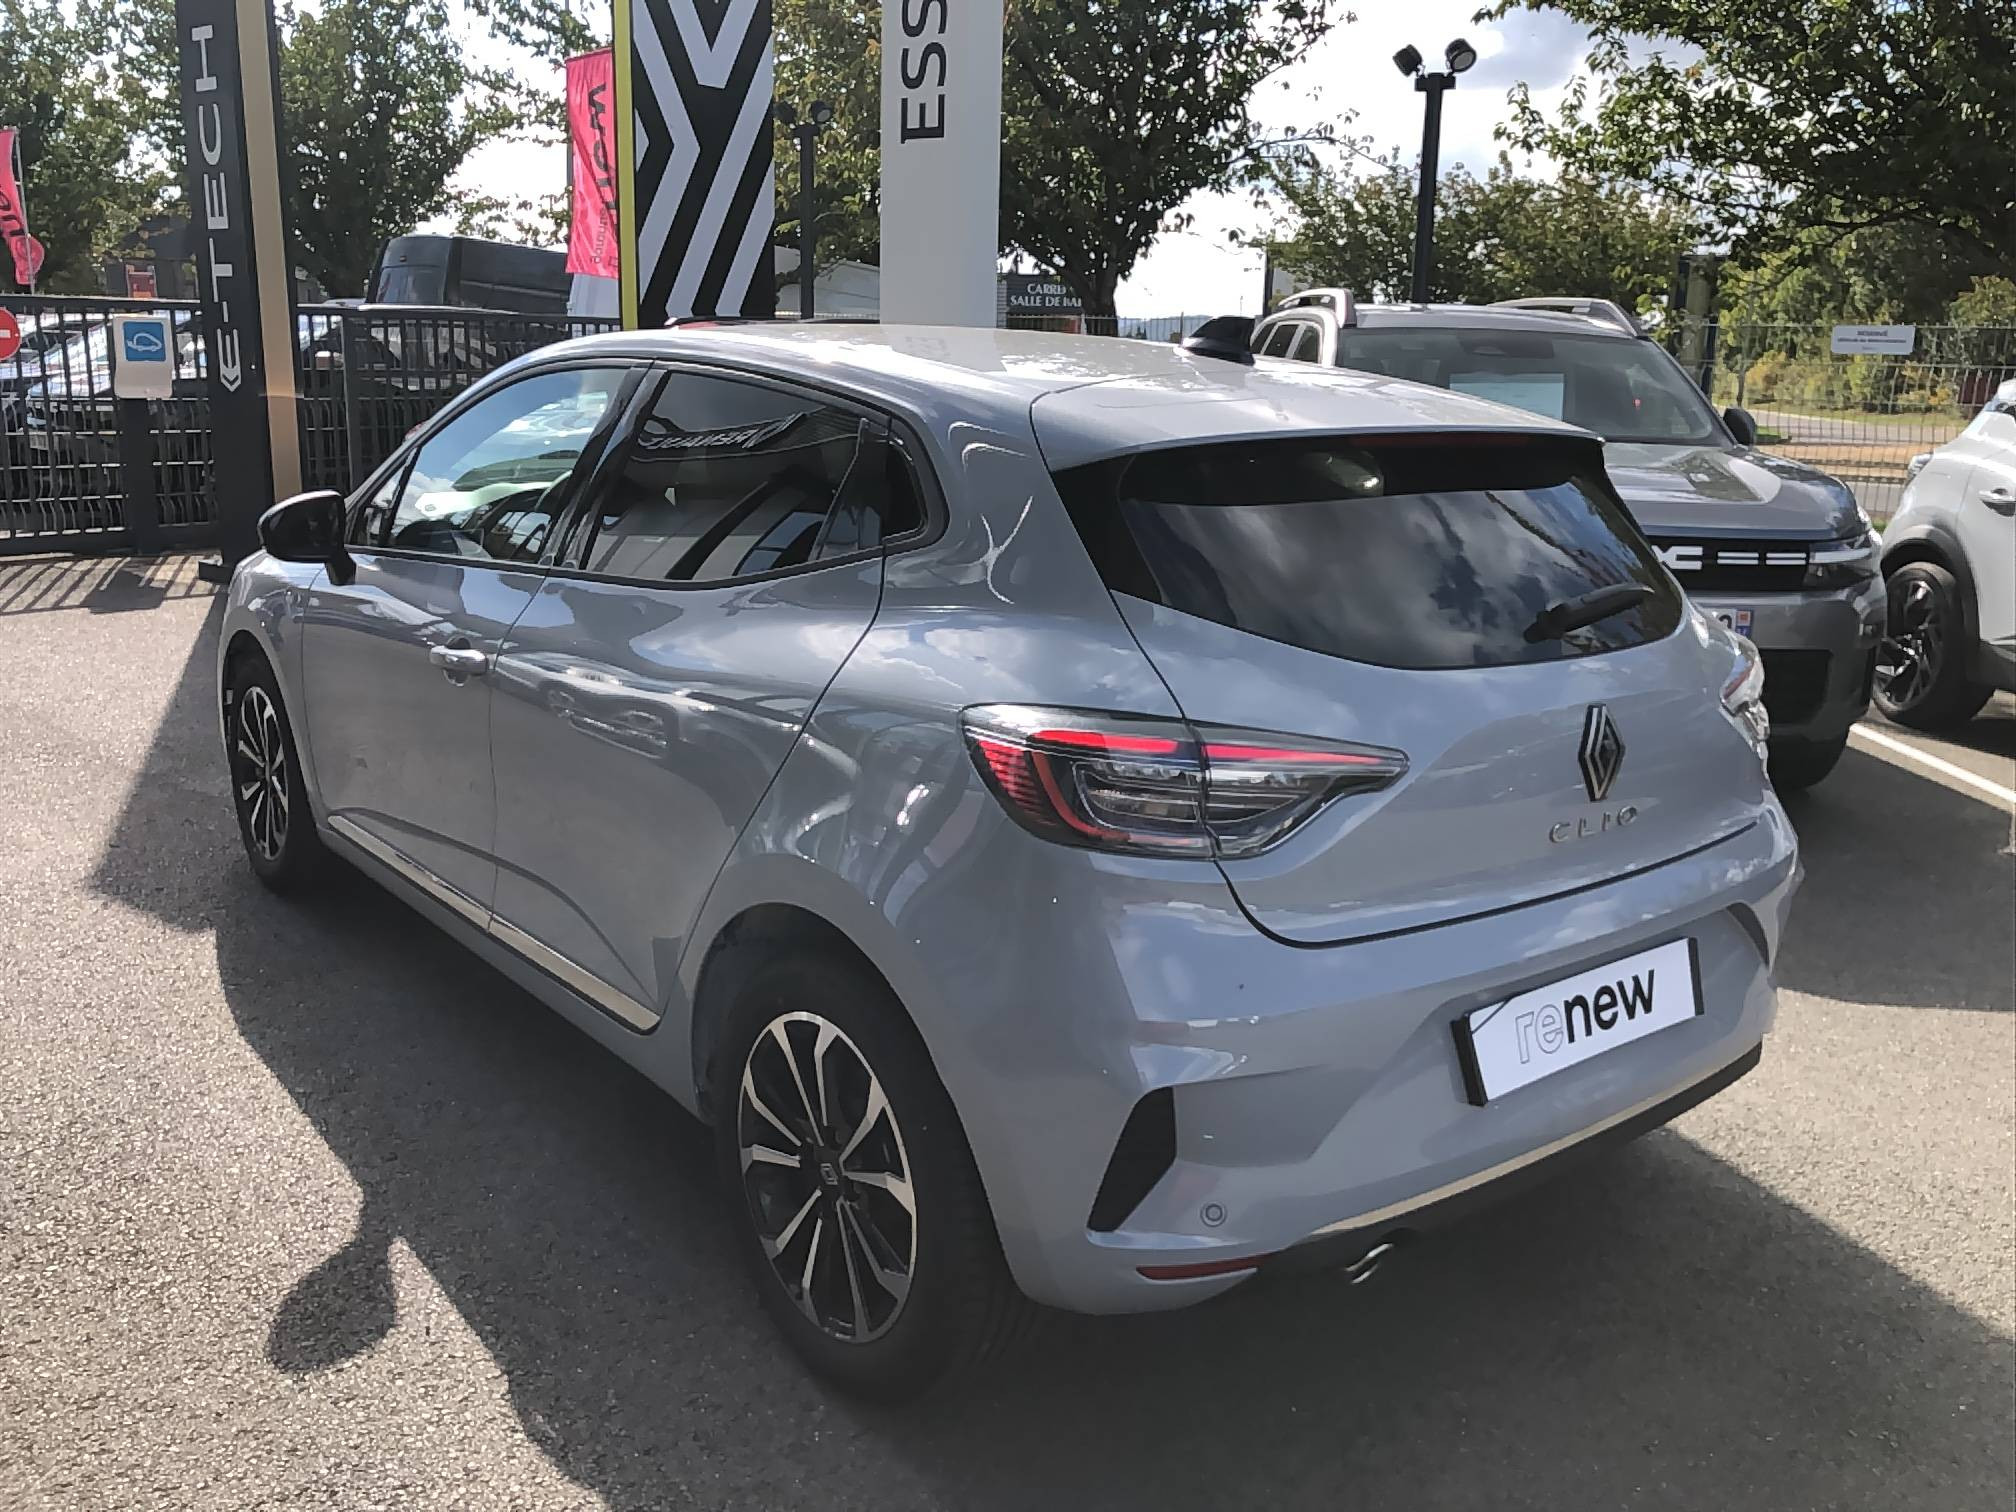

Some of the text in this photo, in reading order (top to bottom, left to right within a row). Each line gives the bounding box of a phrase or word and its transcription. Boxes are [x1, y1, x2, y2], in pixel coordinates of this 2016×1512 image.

[191, 24, 241, 392] E-TECH
[1010, 295, 1042, 307] SALLE
[1045, 296, 1061, 307] DE
[1550, 806, 1638, 843] CLIO
[1515, 969, 1655, 1064] renew
